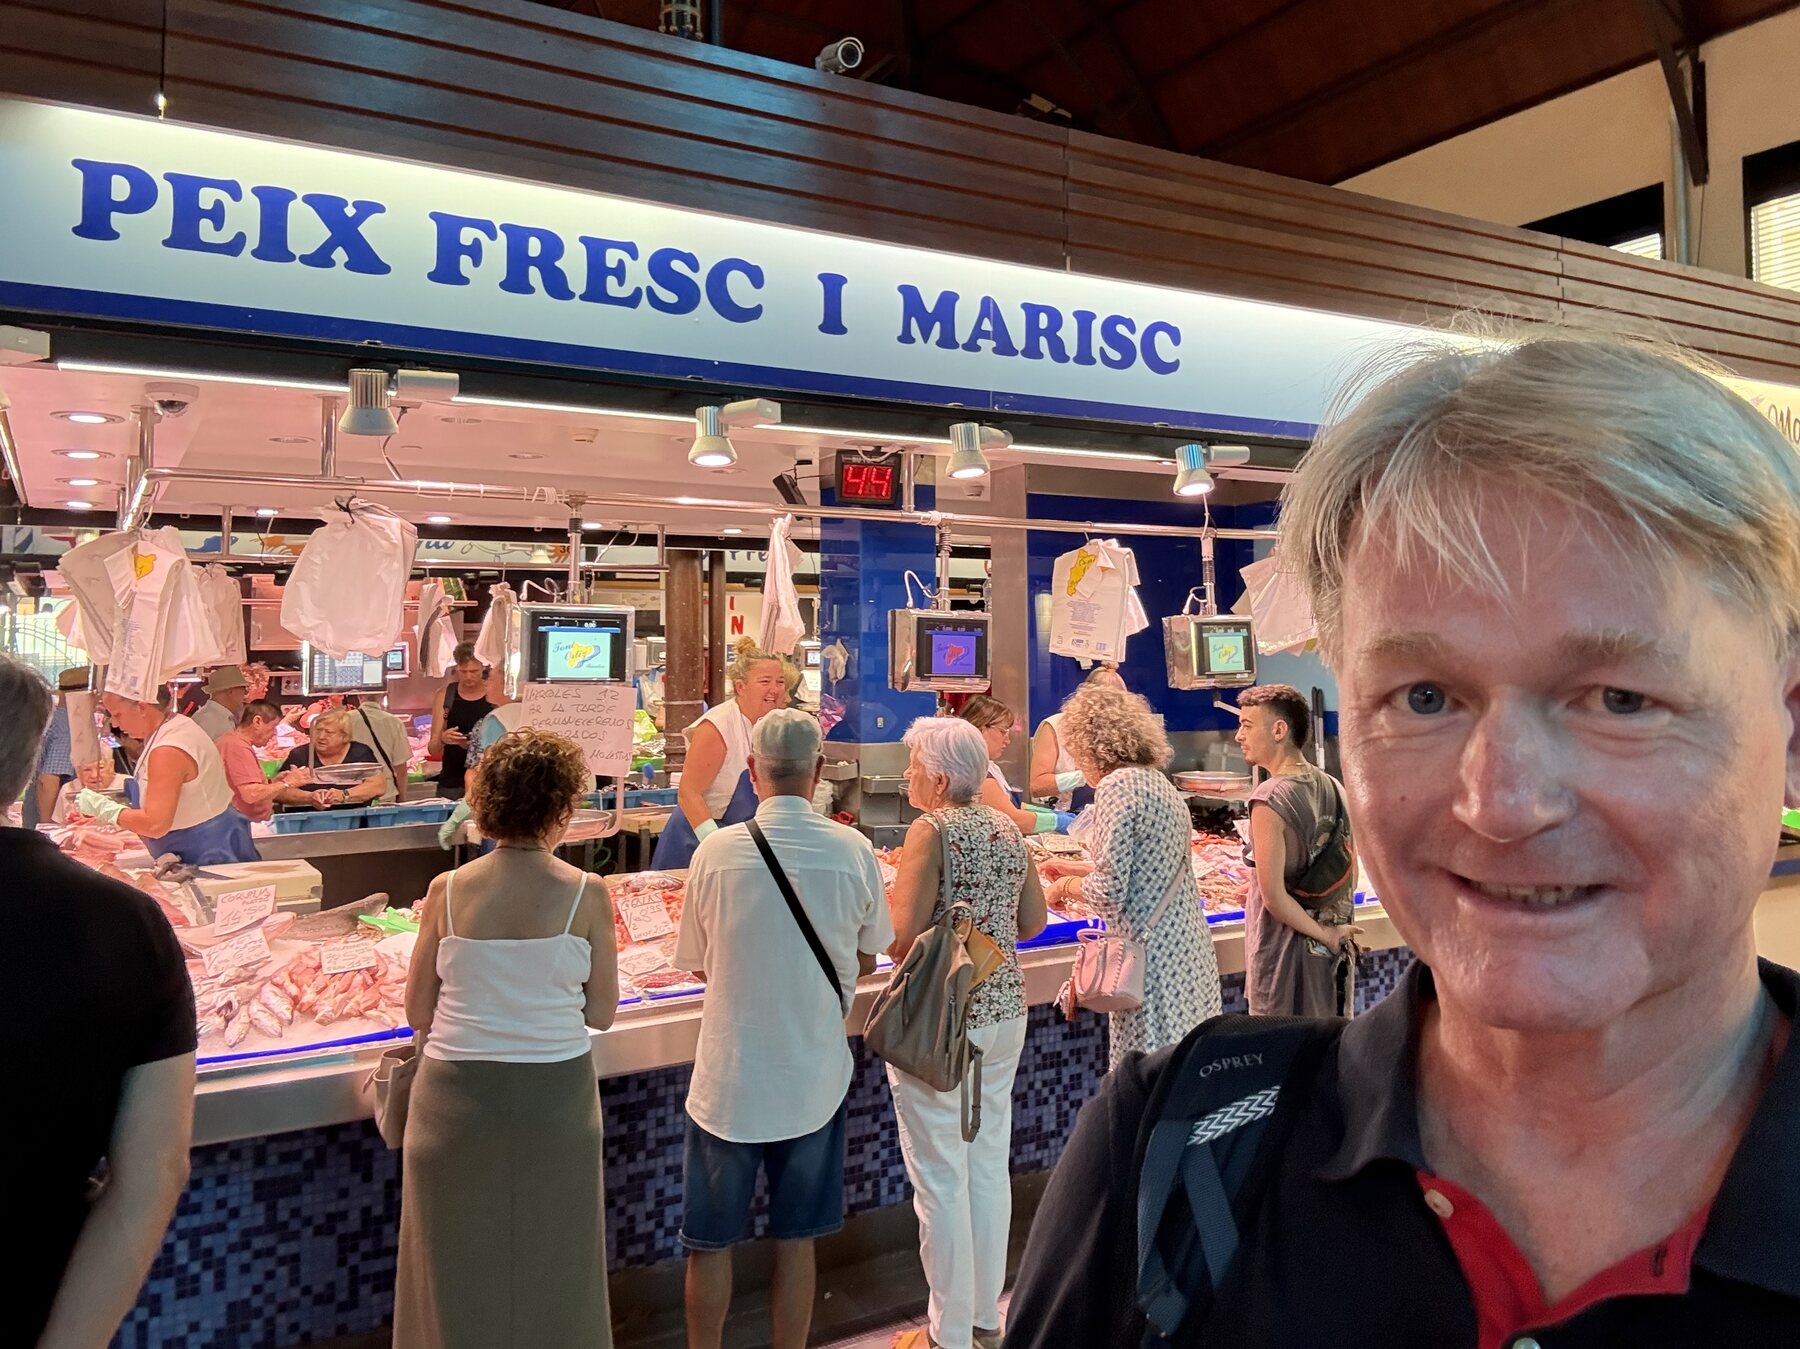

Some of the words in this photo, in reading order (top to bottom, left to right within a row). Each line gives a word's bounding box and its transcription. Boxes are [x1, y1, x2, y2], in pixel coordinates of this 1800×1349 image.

[71, 158, 391, 276] PEIX
[427, 211, 765, 323] FRESC
[817, 272, 848, 336] I
[896, 284, 1182, 376] MARISC
[847, 466, 892, 497] 44
[551, 703, 565, 713] LA
[1200, 1052, 1263, 1077] OSPREY
